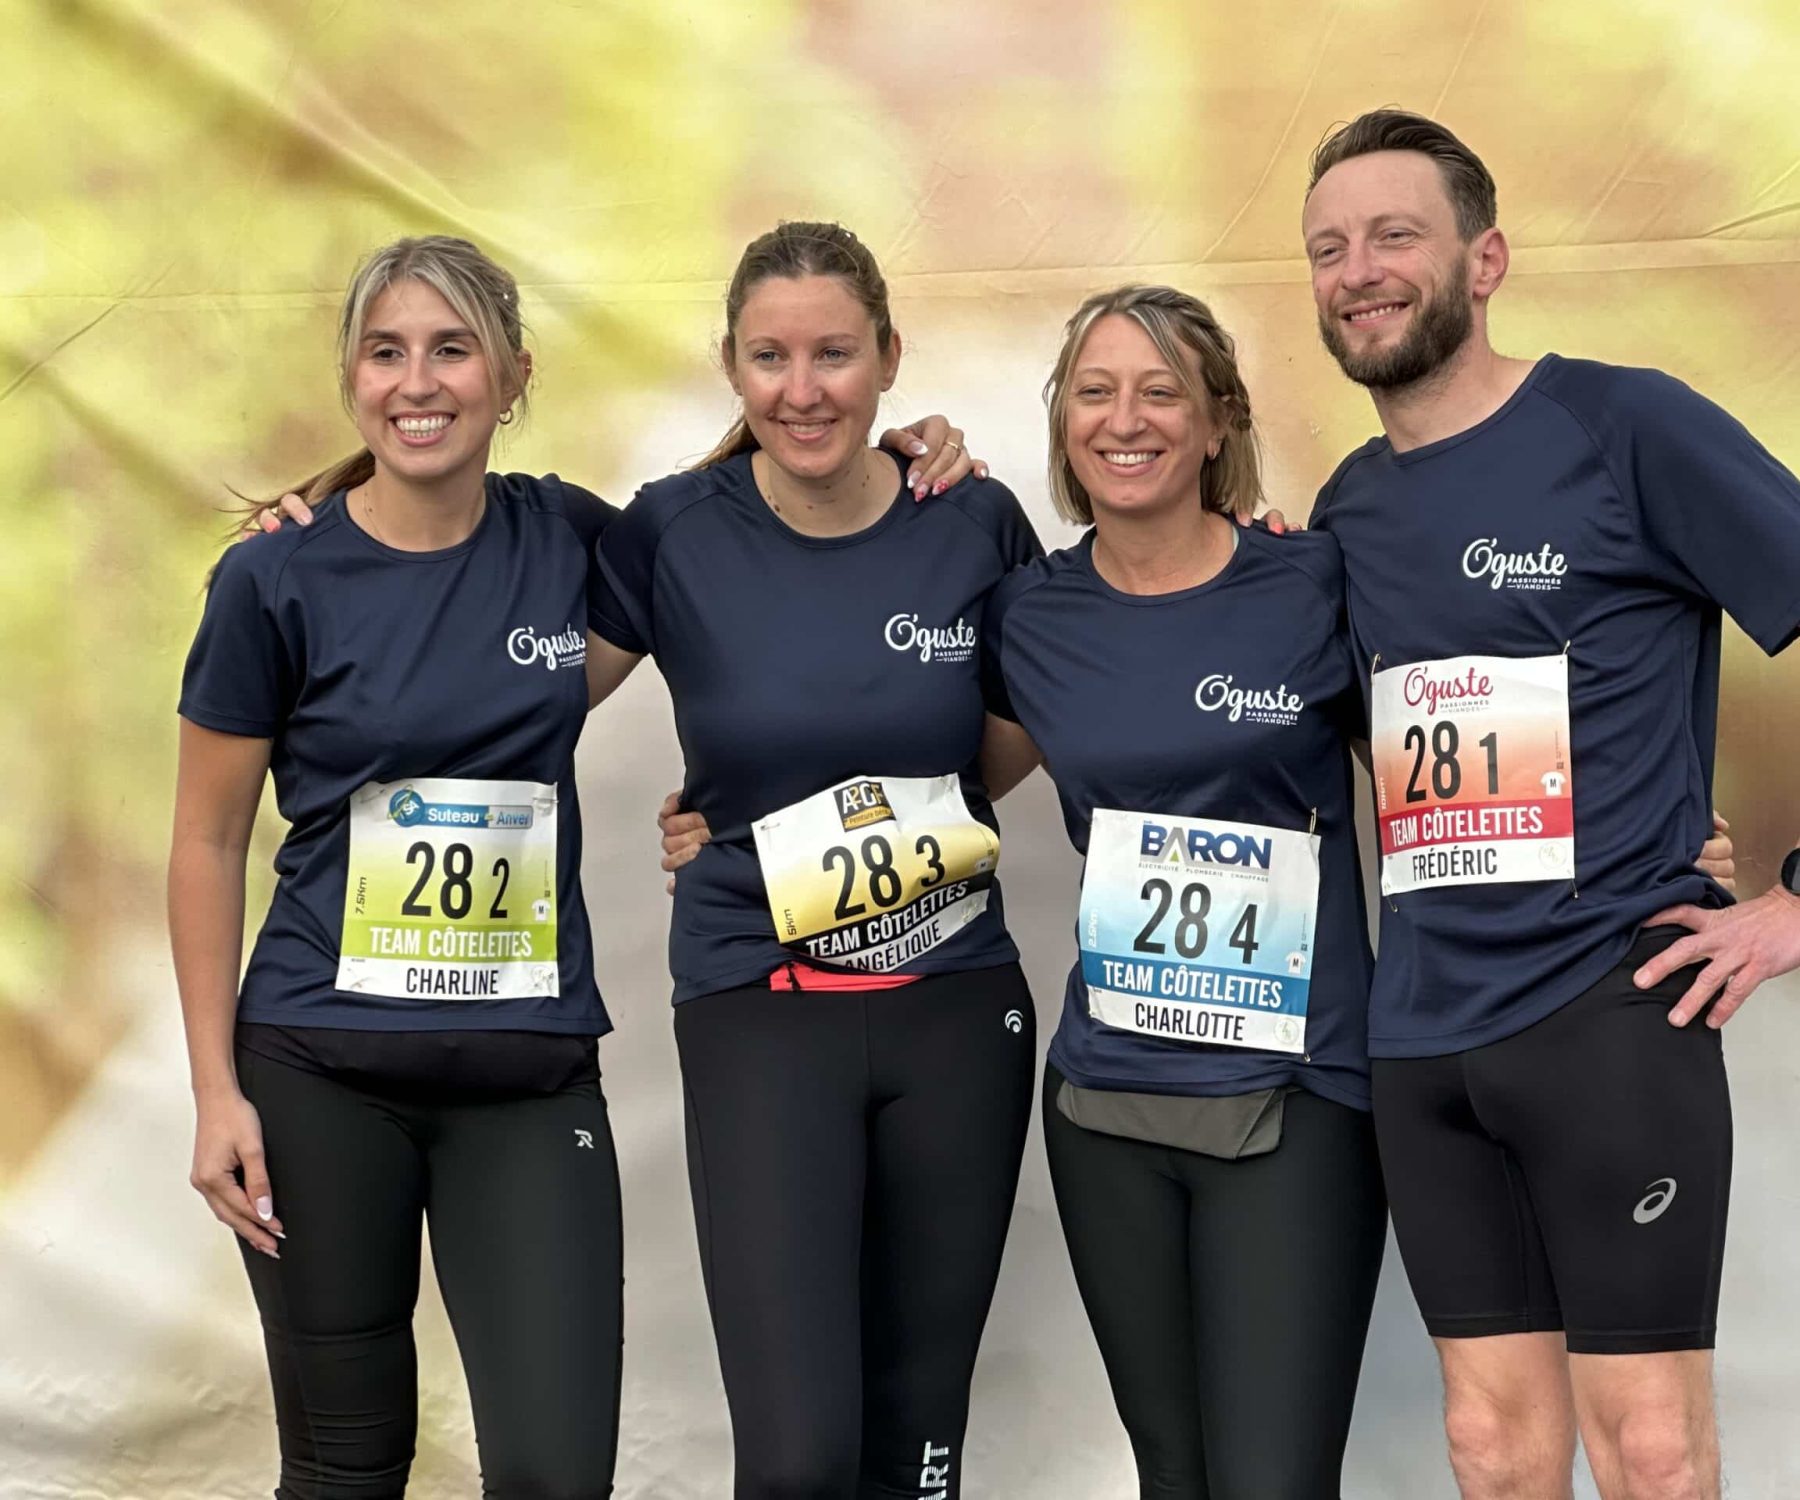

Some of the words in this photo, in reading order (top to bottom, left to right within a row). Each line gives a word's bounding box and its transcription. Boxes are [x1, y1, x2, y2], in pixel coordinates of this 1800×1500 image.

[1463, 538, 1567, 590] O'guste
[507, 623, 586, 671] O'guste
[885, 614, 975, 663] O'guste
[1195, 674, 1304, 722] O'guste
[1404, 666, 1493, 715] O'guste
[1404, 721, 1461, 803] 28
[1479, 732, 1499, 795] 1
[427, 808, 479, 823] Suteau
[1390, 816, 1417, 847] TEAM
[1422, 806, 1543, 840] CÔTELETTES
[1140, 824, 1272, 870] BARON
[1413, 845, 1497, 881] FRÉDÉRIC
[401, 841, 473, 919] 28
[489, 858, 510, 918] 2
[822, 834, 902, 921] 28
[915, 834, 945, 887] 3
[370, 927, 421, 955] TEAM
[428, 926, 532, 958] CÔTELETTES
[806, 925, 860, 958] TEAM
[867, 881, 969, 944] CÔTELETTES
[1133, 878, 1212, 959] 28
[1229, 904, 1258, 965] 4
[406, 968, 499, 995] CHARLINE
[1103, 960, 1154, 992] TEAM
[1160, 964, 1283, 1008] CÔTELETTES
[1135, 1003, 1246, 1041] CHARLOTTE
